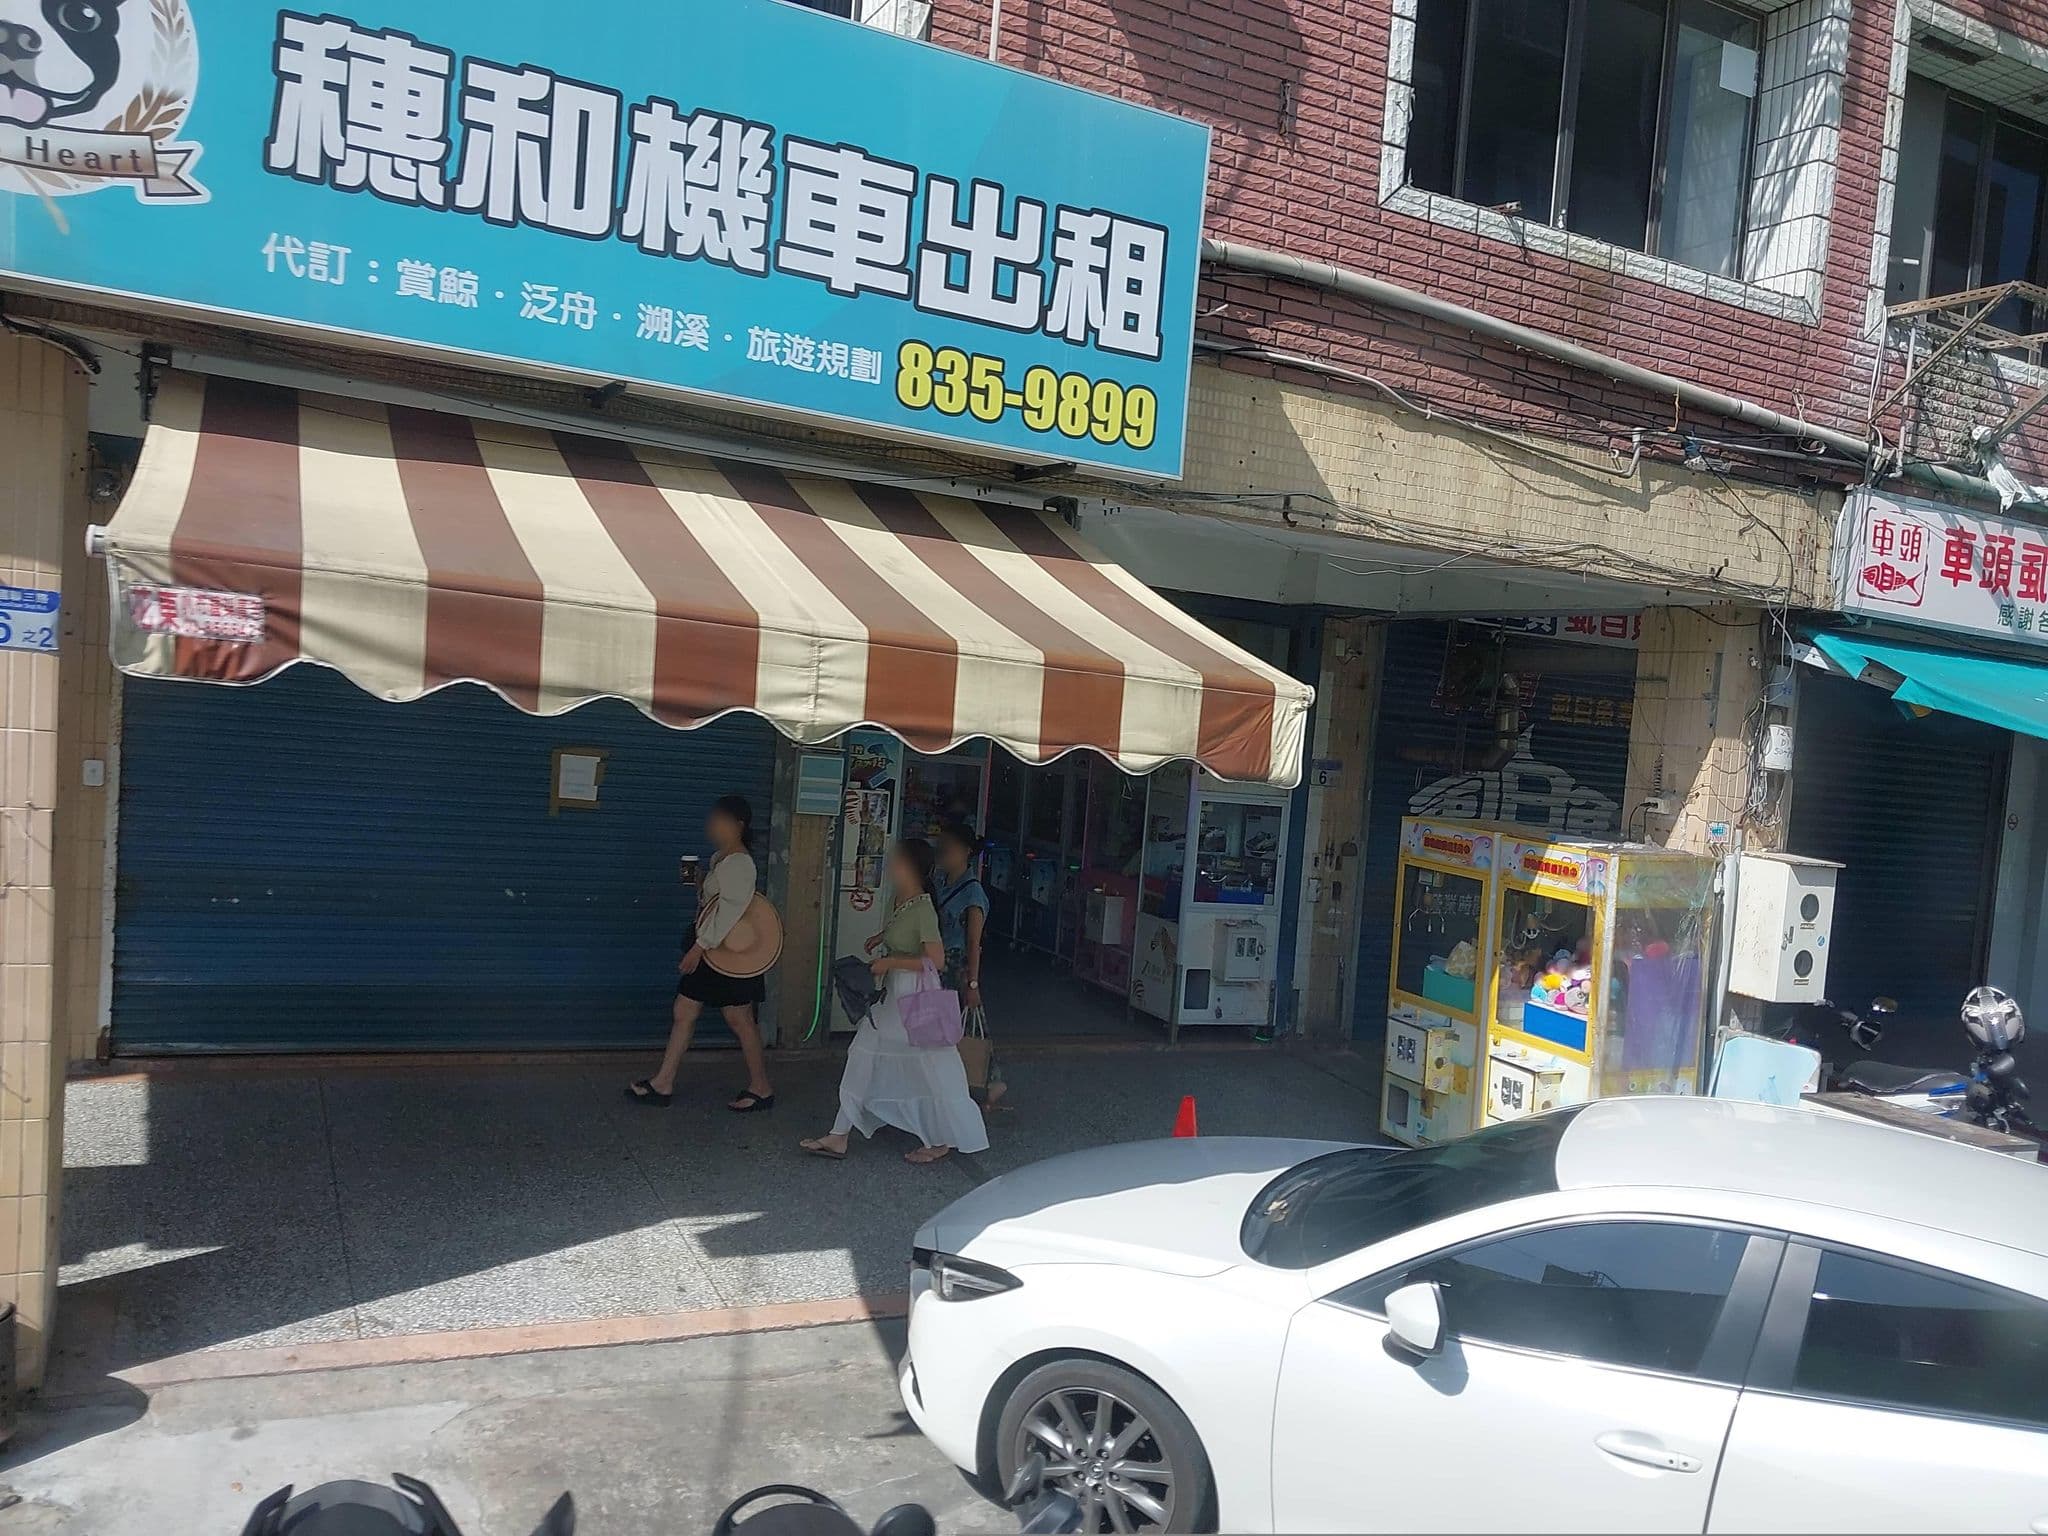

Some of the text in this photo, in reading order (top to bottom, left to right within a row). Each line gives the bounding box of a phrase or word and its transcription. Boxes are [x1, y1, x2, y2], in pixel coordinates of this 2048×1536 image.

[24, 135, 142, 173] Heart
[264, 8, 1168, 358] 穗和機車出租
[896, 341, 1157, 449] 835-9899
[1871, 519, 1922, 563] 車頭
